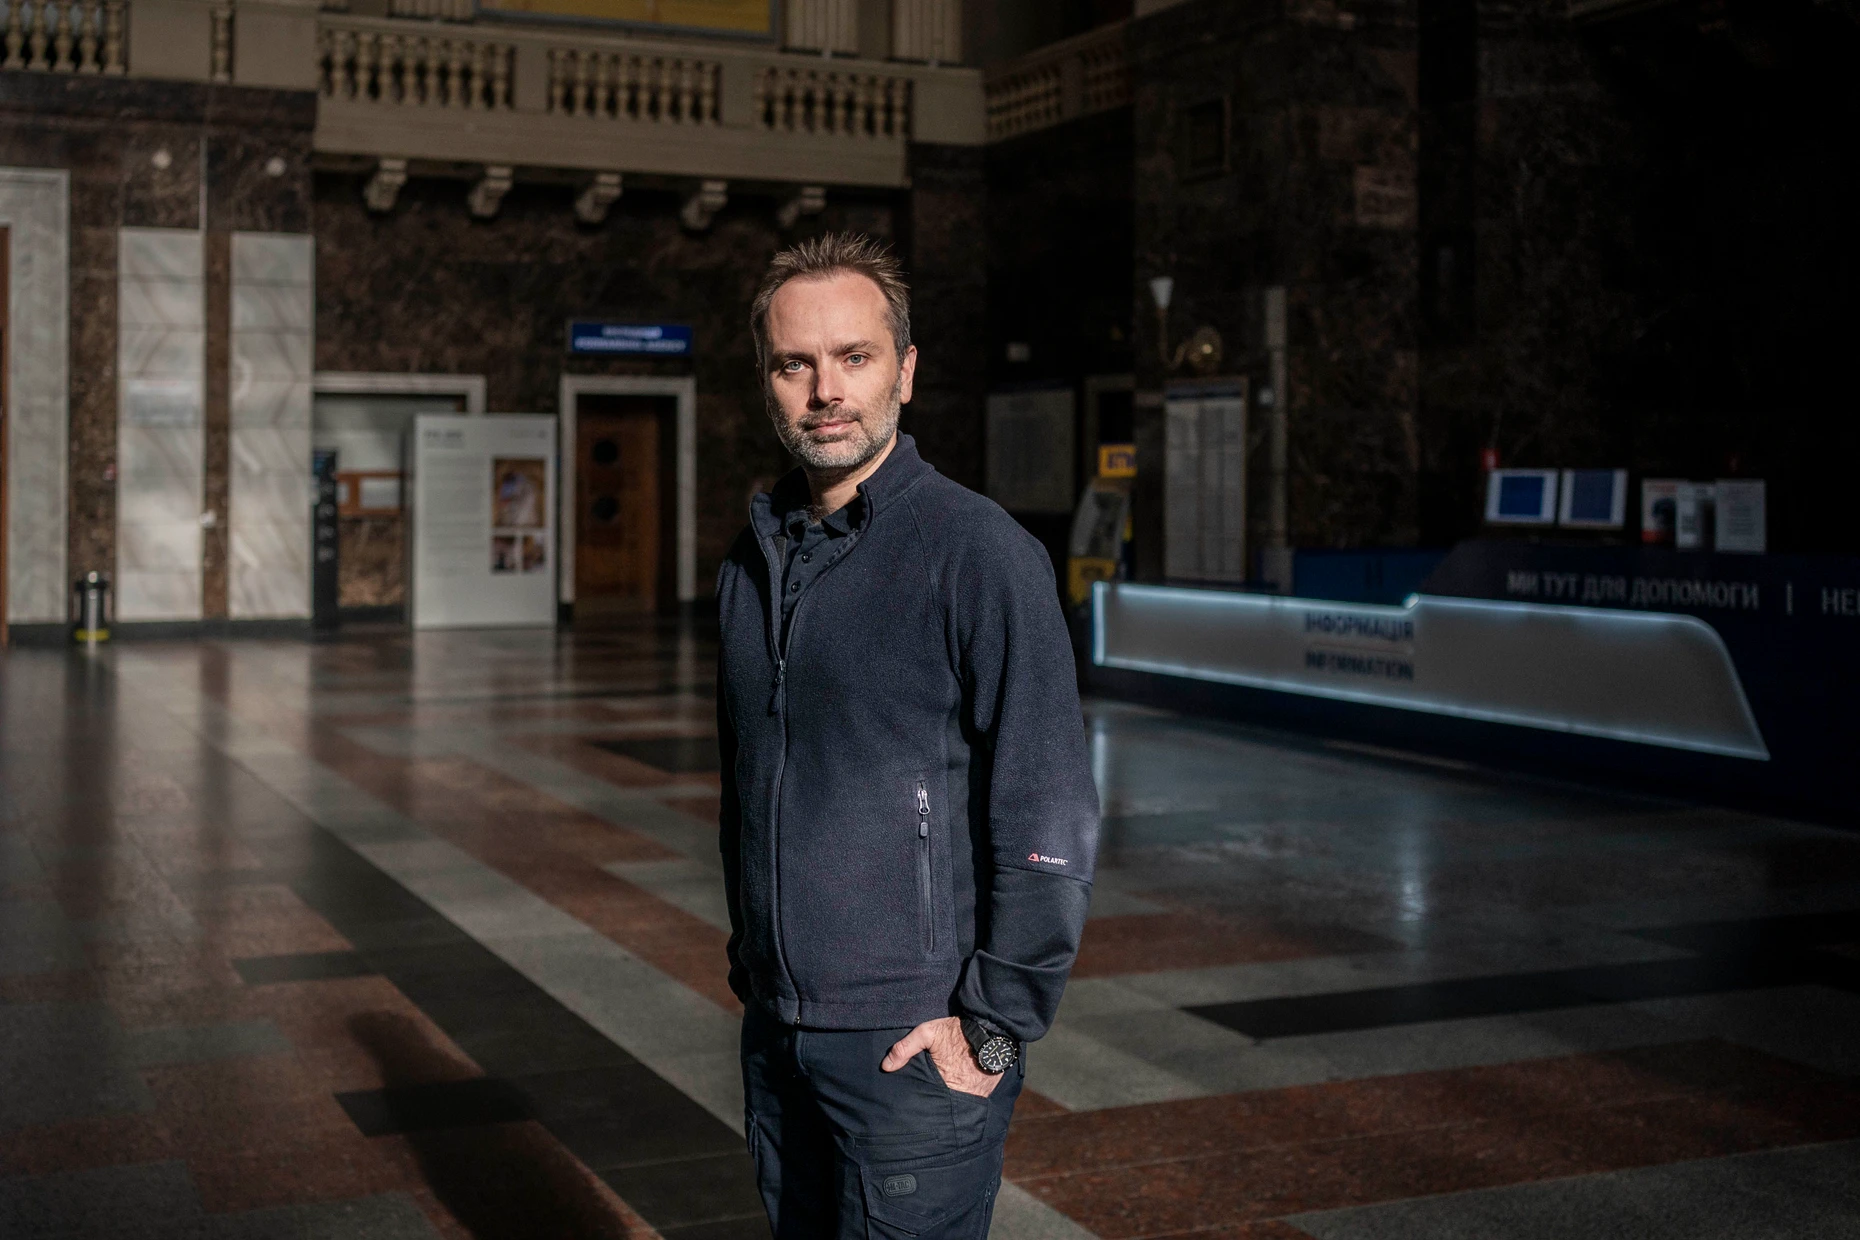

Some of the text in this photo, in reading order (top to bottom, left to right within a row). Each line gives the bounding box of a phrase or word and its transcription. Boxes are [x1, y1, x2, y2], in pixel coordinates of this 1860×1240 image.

[1506, 570, 1539, 596] МИ
[1542, 571, 1580, 598] ТУТ
[1582, 573, 1627, 604] ДЛЯ
[1630, 576, 1759, 610] ДОПОМОГИ
[1305, 650, 1414, 682] INFORMATION
[1039, 855, 1068, 866] POLARTEC
